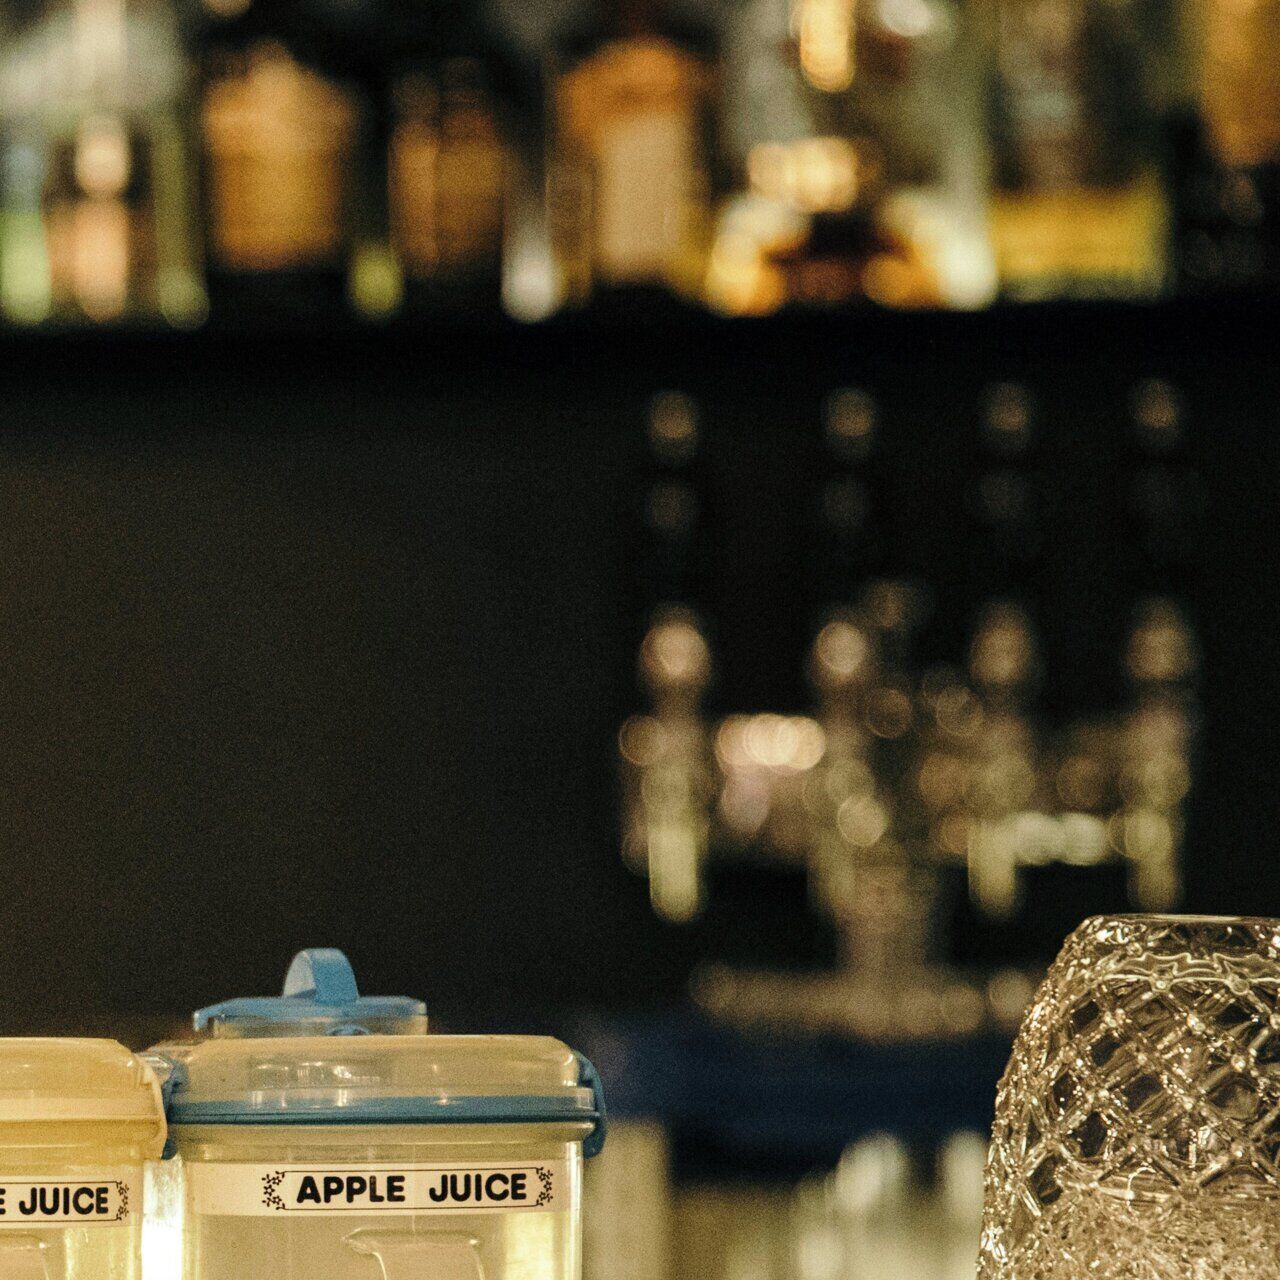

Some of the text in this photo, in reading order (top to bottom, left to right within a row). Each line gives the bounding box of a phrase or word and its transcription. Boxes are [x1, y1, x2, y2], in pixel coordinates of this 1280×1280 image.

[18, 1185, 110, 1216] JUICE
[295, 1172, 528, 1204] APPLE JUICE
